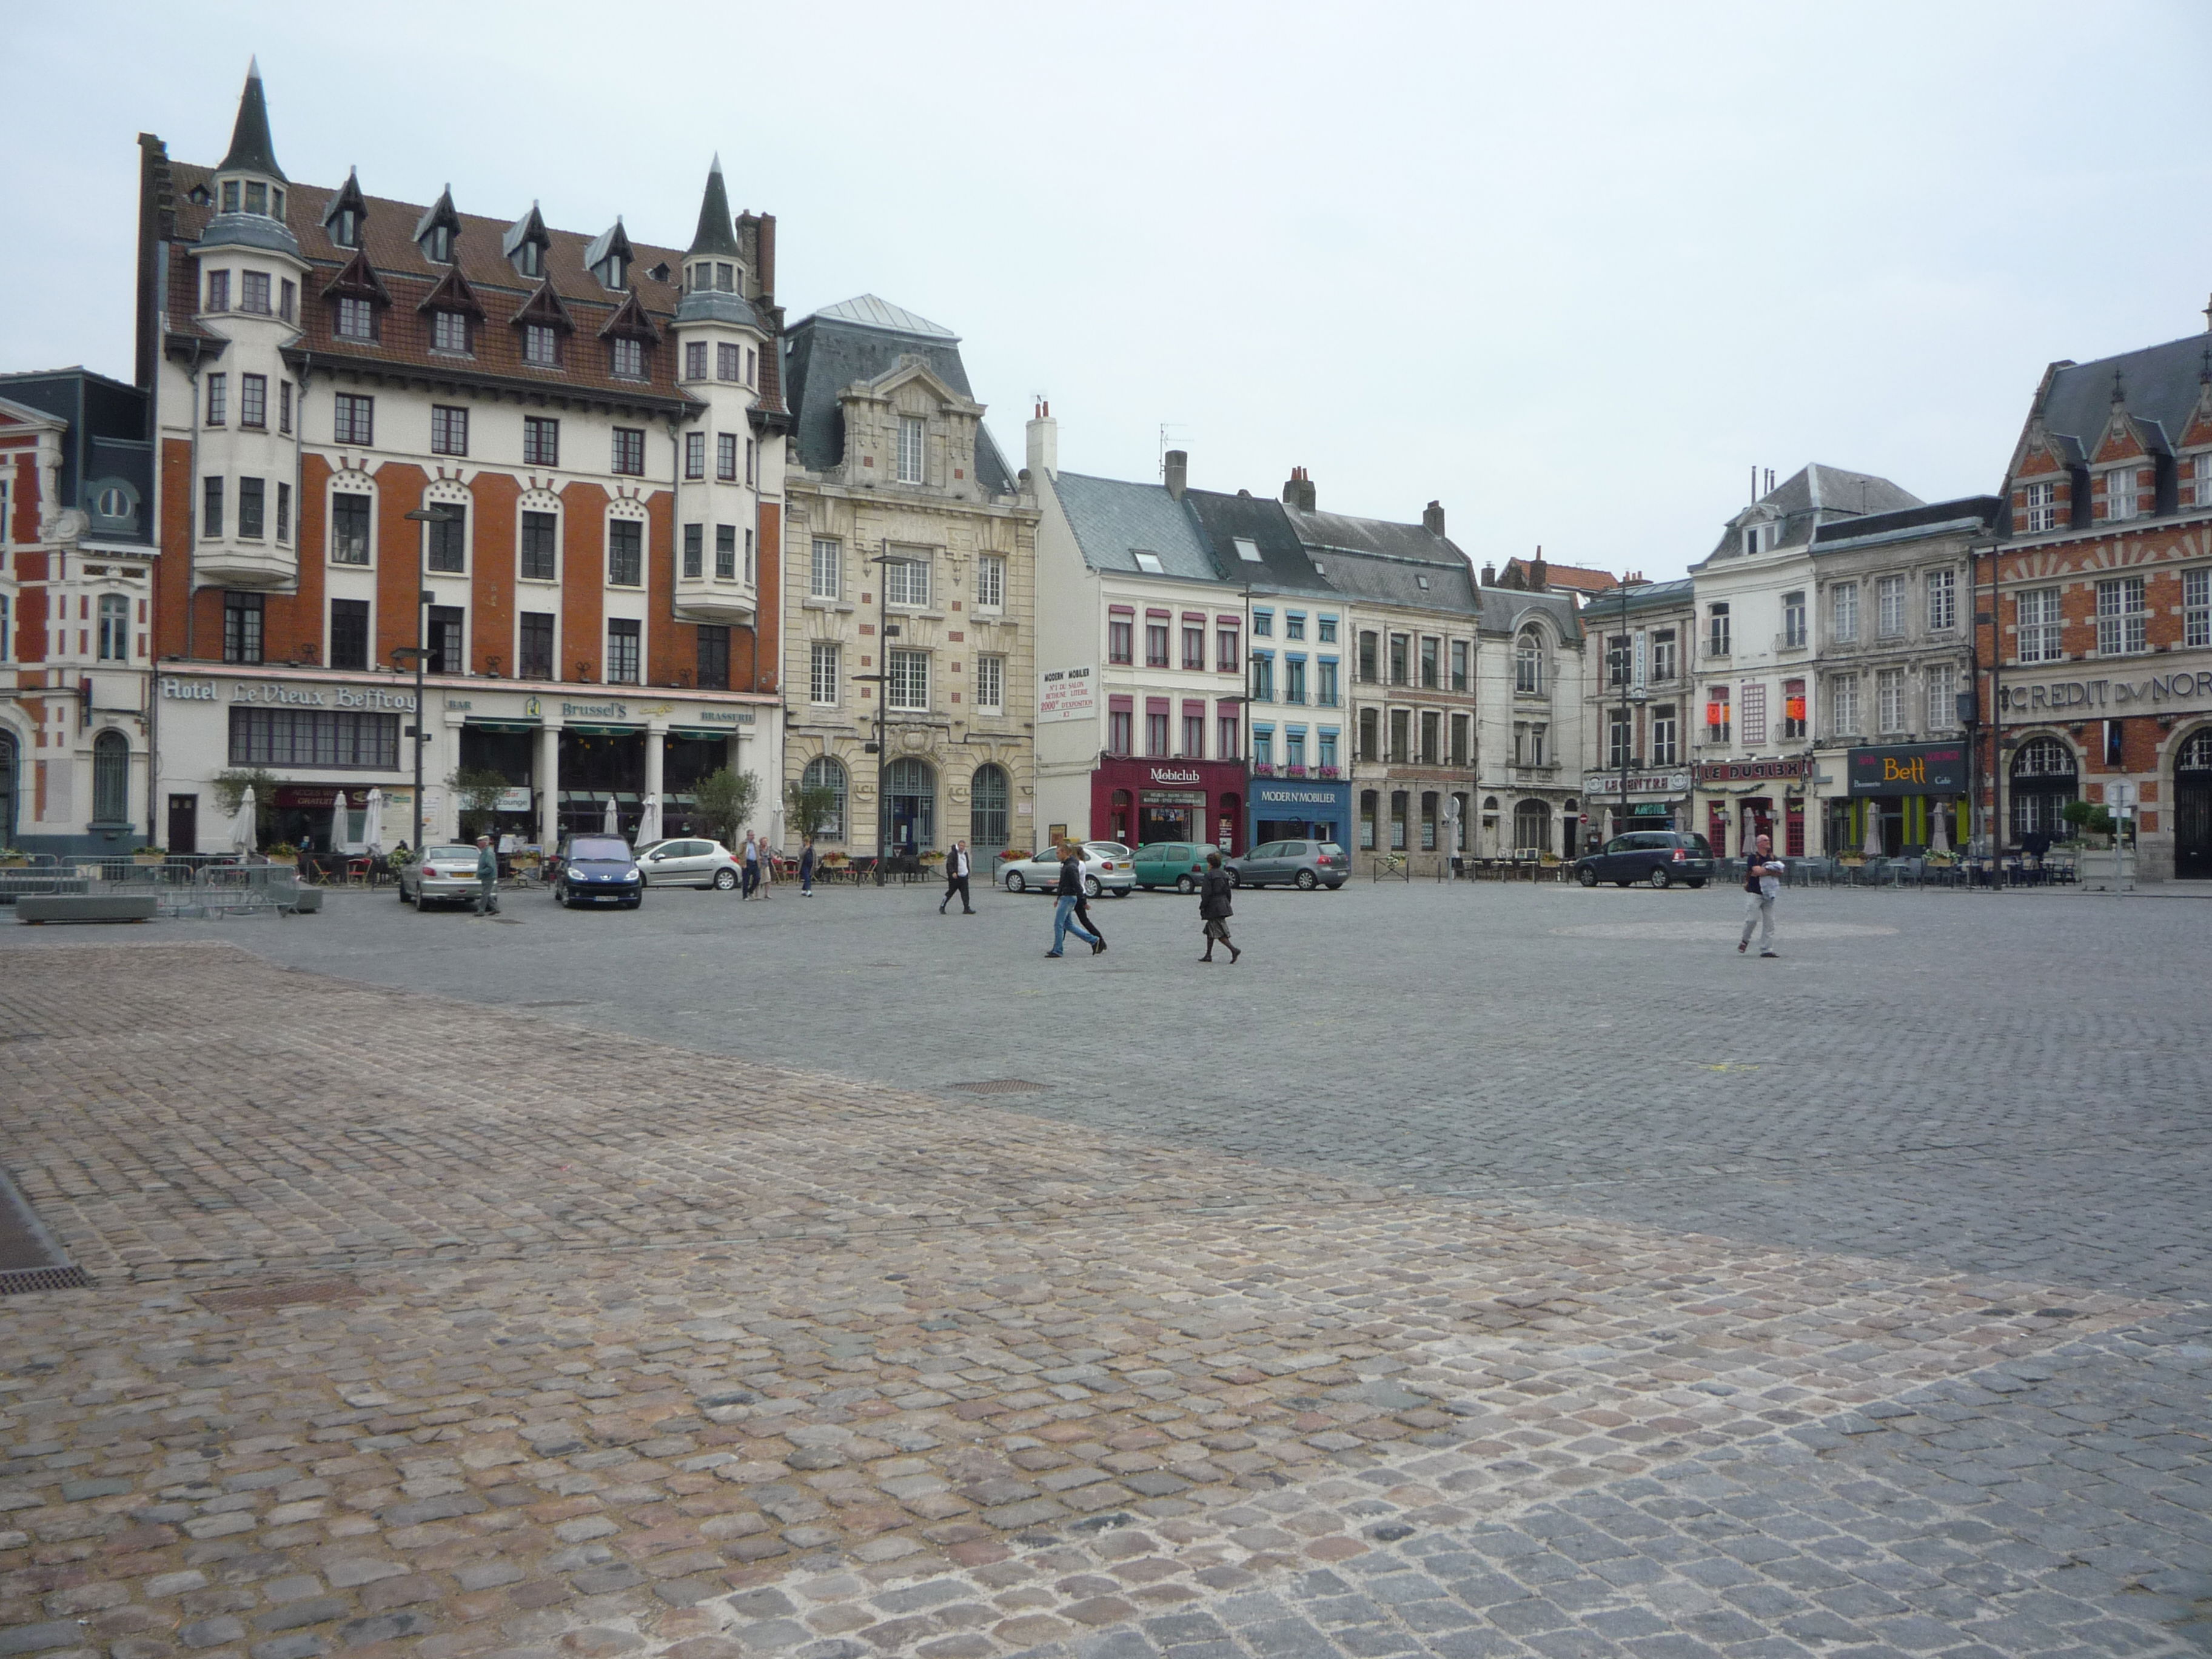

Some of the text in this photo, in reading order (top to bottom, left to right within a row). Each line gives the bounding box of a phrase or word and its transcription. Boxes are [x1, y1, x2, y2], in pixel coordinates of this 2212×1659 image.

[1068, 668, 1090, 679] MOBILIER
[160, 679, 417, 713] Hotel Le Vieux Beffroy
[2010, 680, 2108, 709] CREDIT
[449, 700, 472, 709] BAR
[1062, 700, 1093, 708] D'EXPOSITION
[701, 712, 754, 722] BRASSERIE
[1704, 762, 1798, 779] LE DUPLEX
[1883, 757, 1926, 783] Bett
[1150, 768, 1200, 784] Mobiclub
[855, 785, 876, 793] LCL
[1605, 780, 1618, 791] LE
[950, 787, 970, 797] LCL
